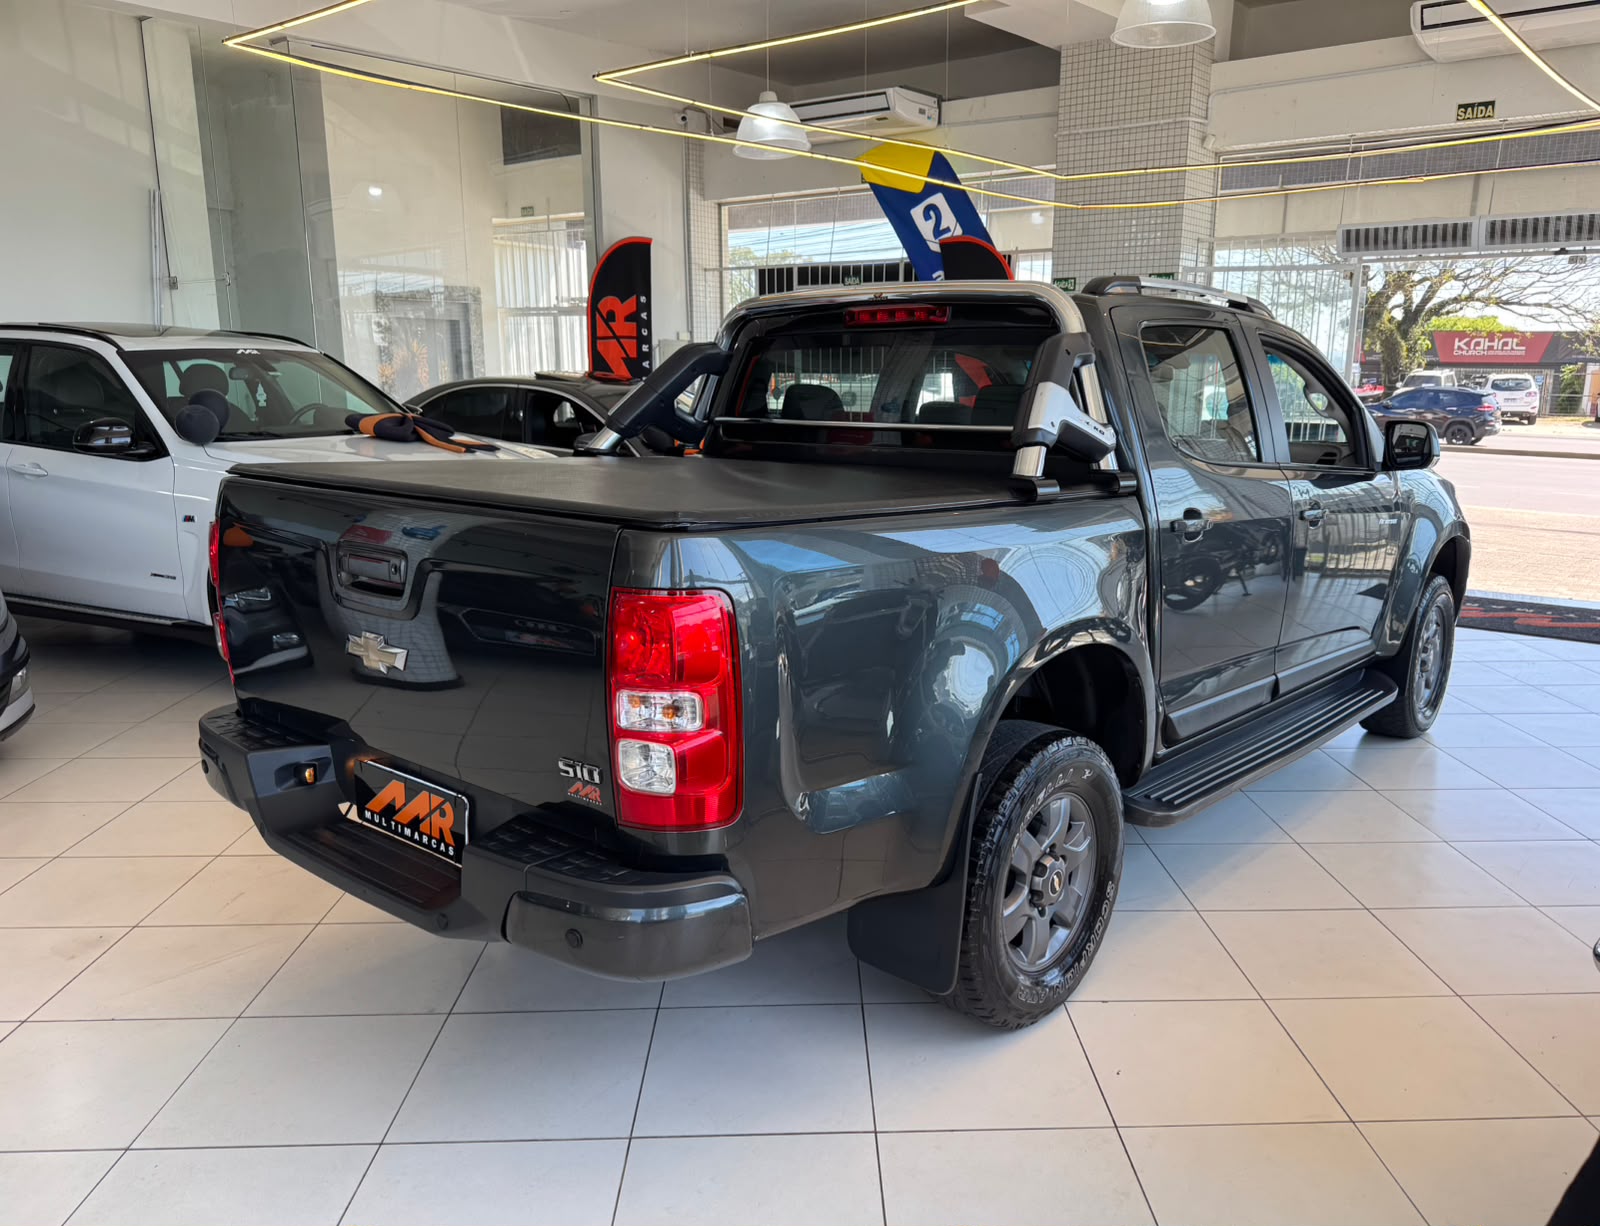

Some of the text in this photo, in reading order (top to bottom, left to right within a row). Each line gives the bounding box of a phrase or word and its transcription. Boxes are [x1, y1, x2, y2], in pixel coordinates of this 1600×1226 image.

[1457, 103, 1494, 120] SAÍDA
[923, 203, 952, 241] 2
[1454, 337, 1526, 350] KAHAL
[558, 757, 601, 785] S10
[364, 809, 455, 856] MULTIMARCAS
